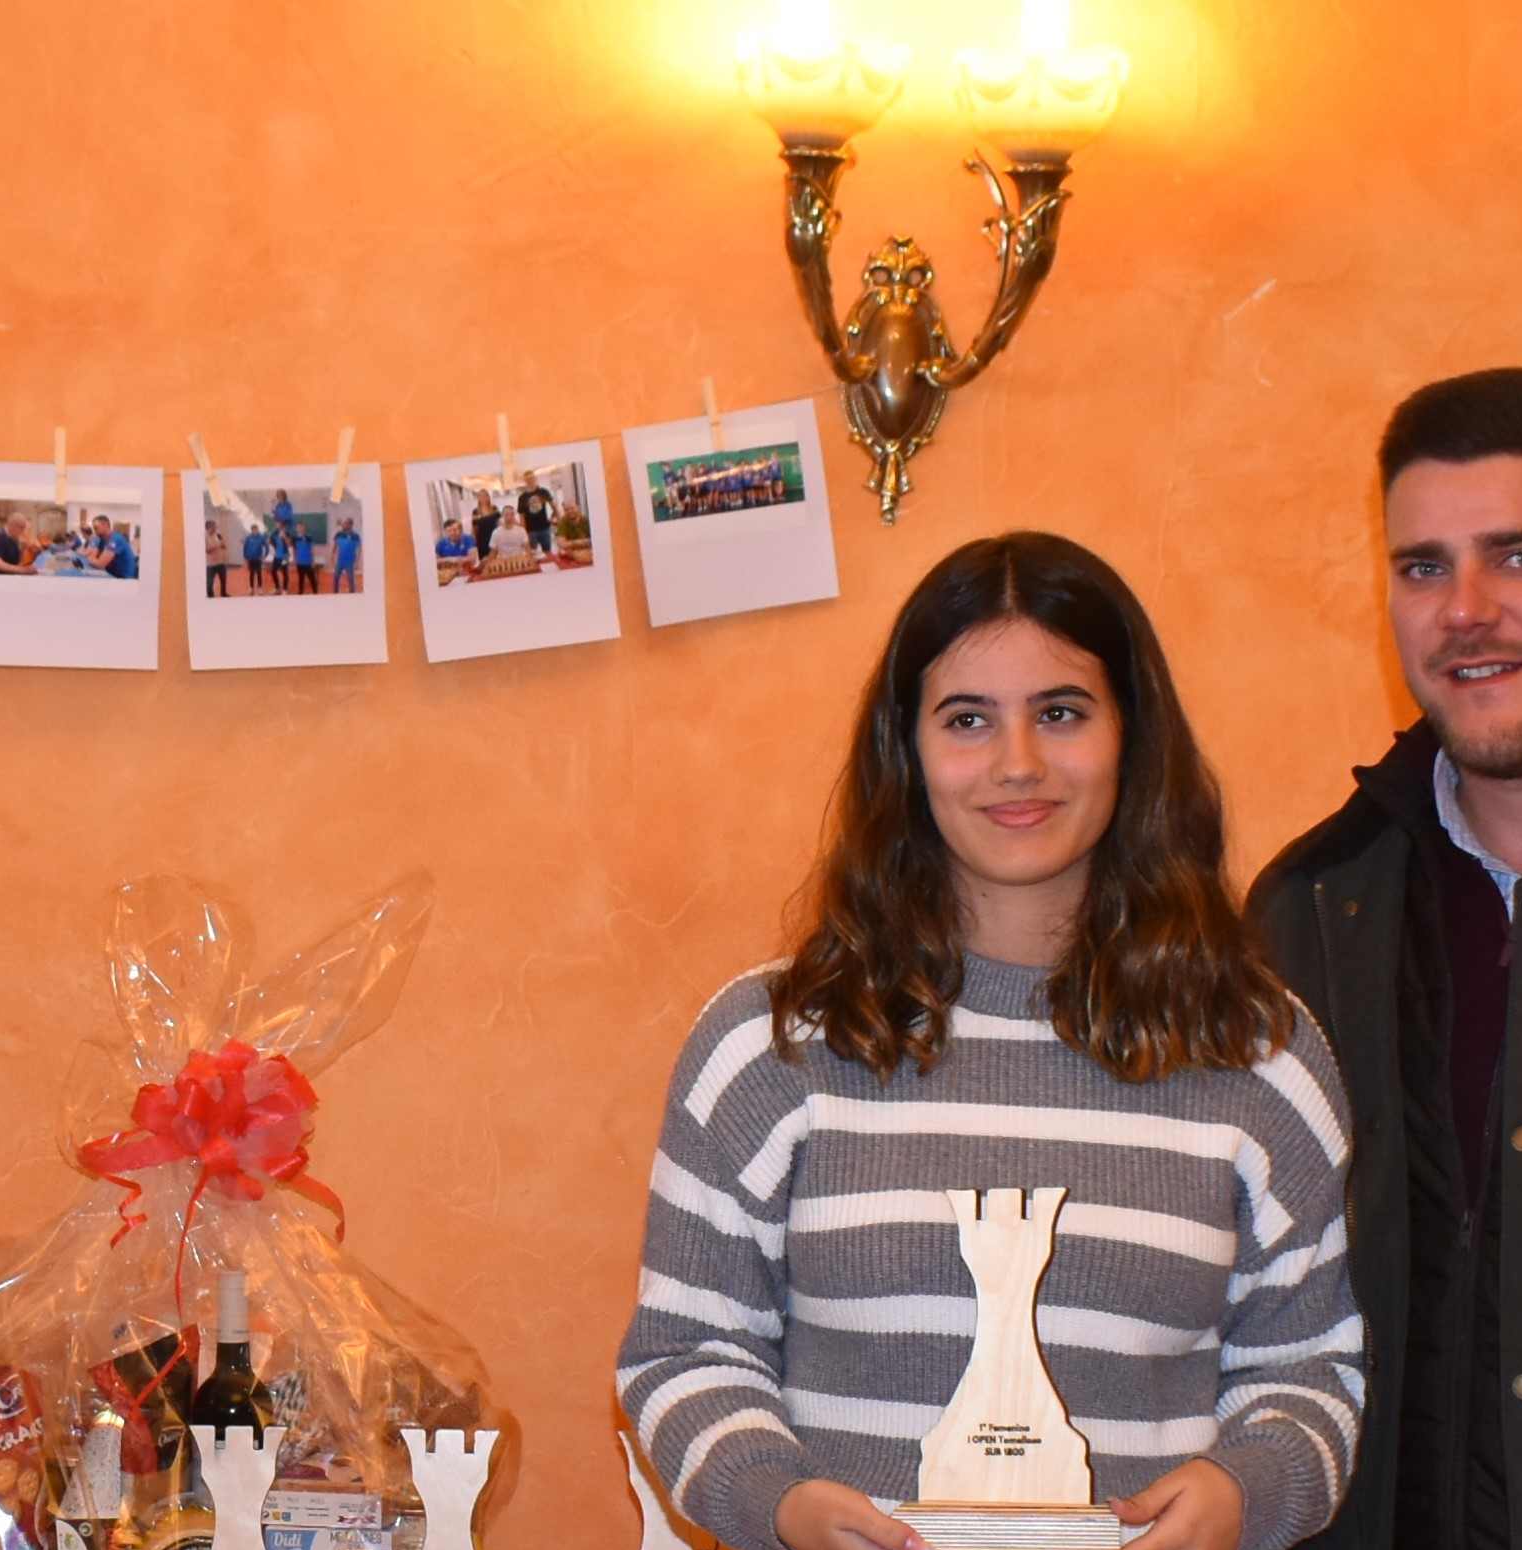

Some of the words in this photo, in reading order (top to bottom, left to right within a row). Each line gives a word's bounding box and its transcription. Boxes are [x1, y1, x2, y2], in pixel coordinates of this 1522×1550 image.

[972, 1435, 996, 1444] OPEN
[984, 1447, 1001, 1456] SUB
[274, 1532, 302, 1548] Didi
